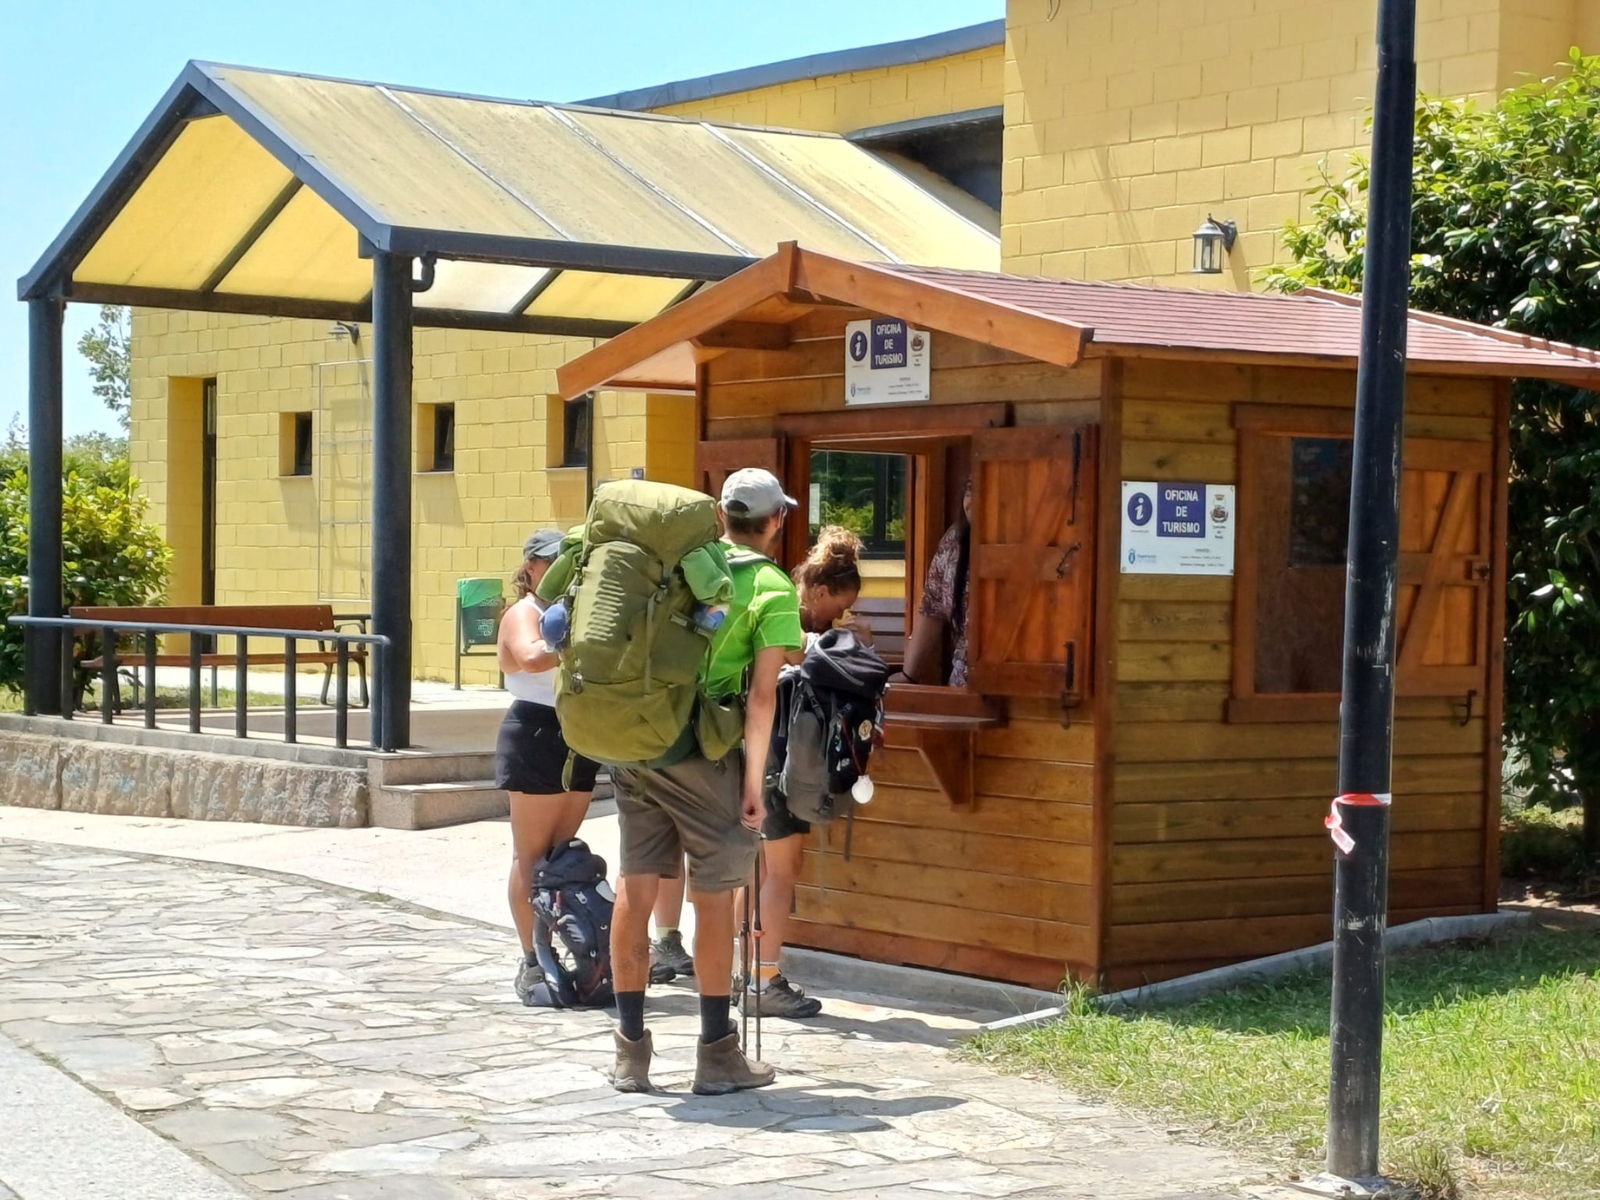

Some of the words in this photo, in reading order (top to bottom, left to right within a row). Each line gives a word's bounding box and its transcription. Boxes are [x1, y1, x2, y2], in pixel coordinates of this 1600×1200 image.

[876, 323, 902, 335] OFICINA
[884, 339, 894, 350] DE
[875, 353, 903, 365] TURISMO
[1164, 489, 1199, 502] OFICINA
[1175, 505, 1188, 517] DE
[1162, 521, 1200, 534] TURISMO
